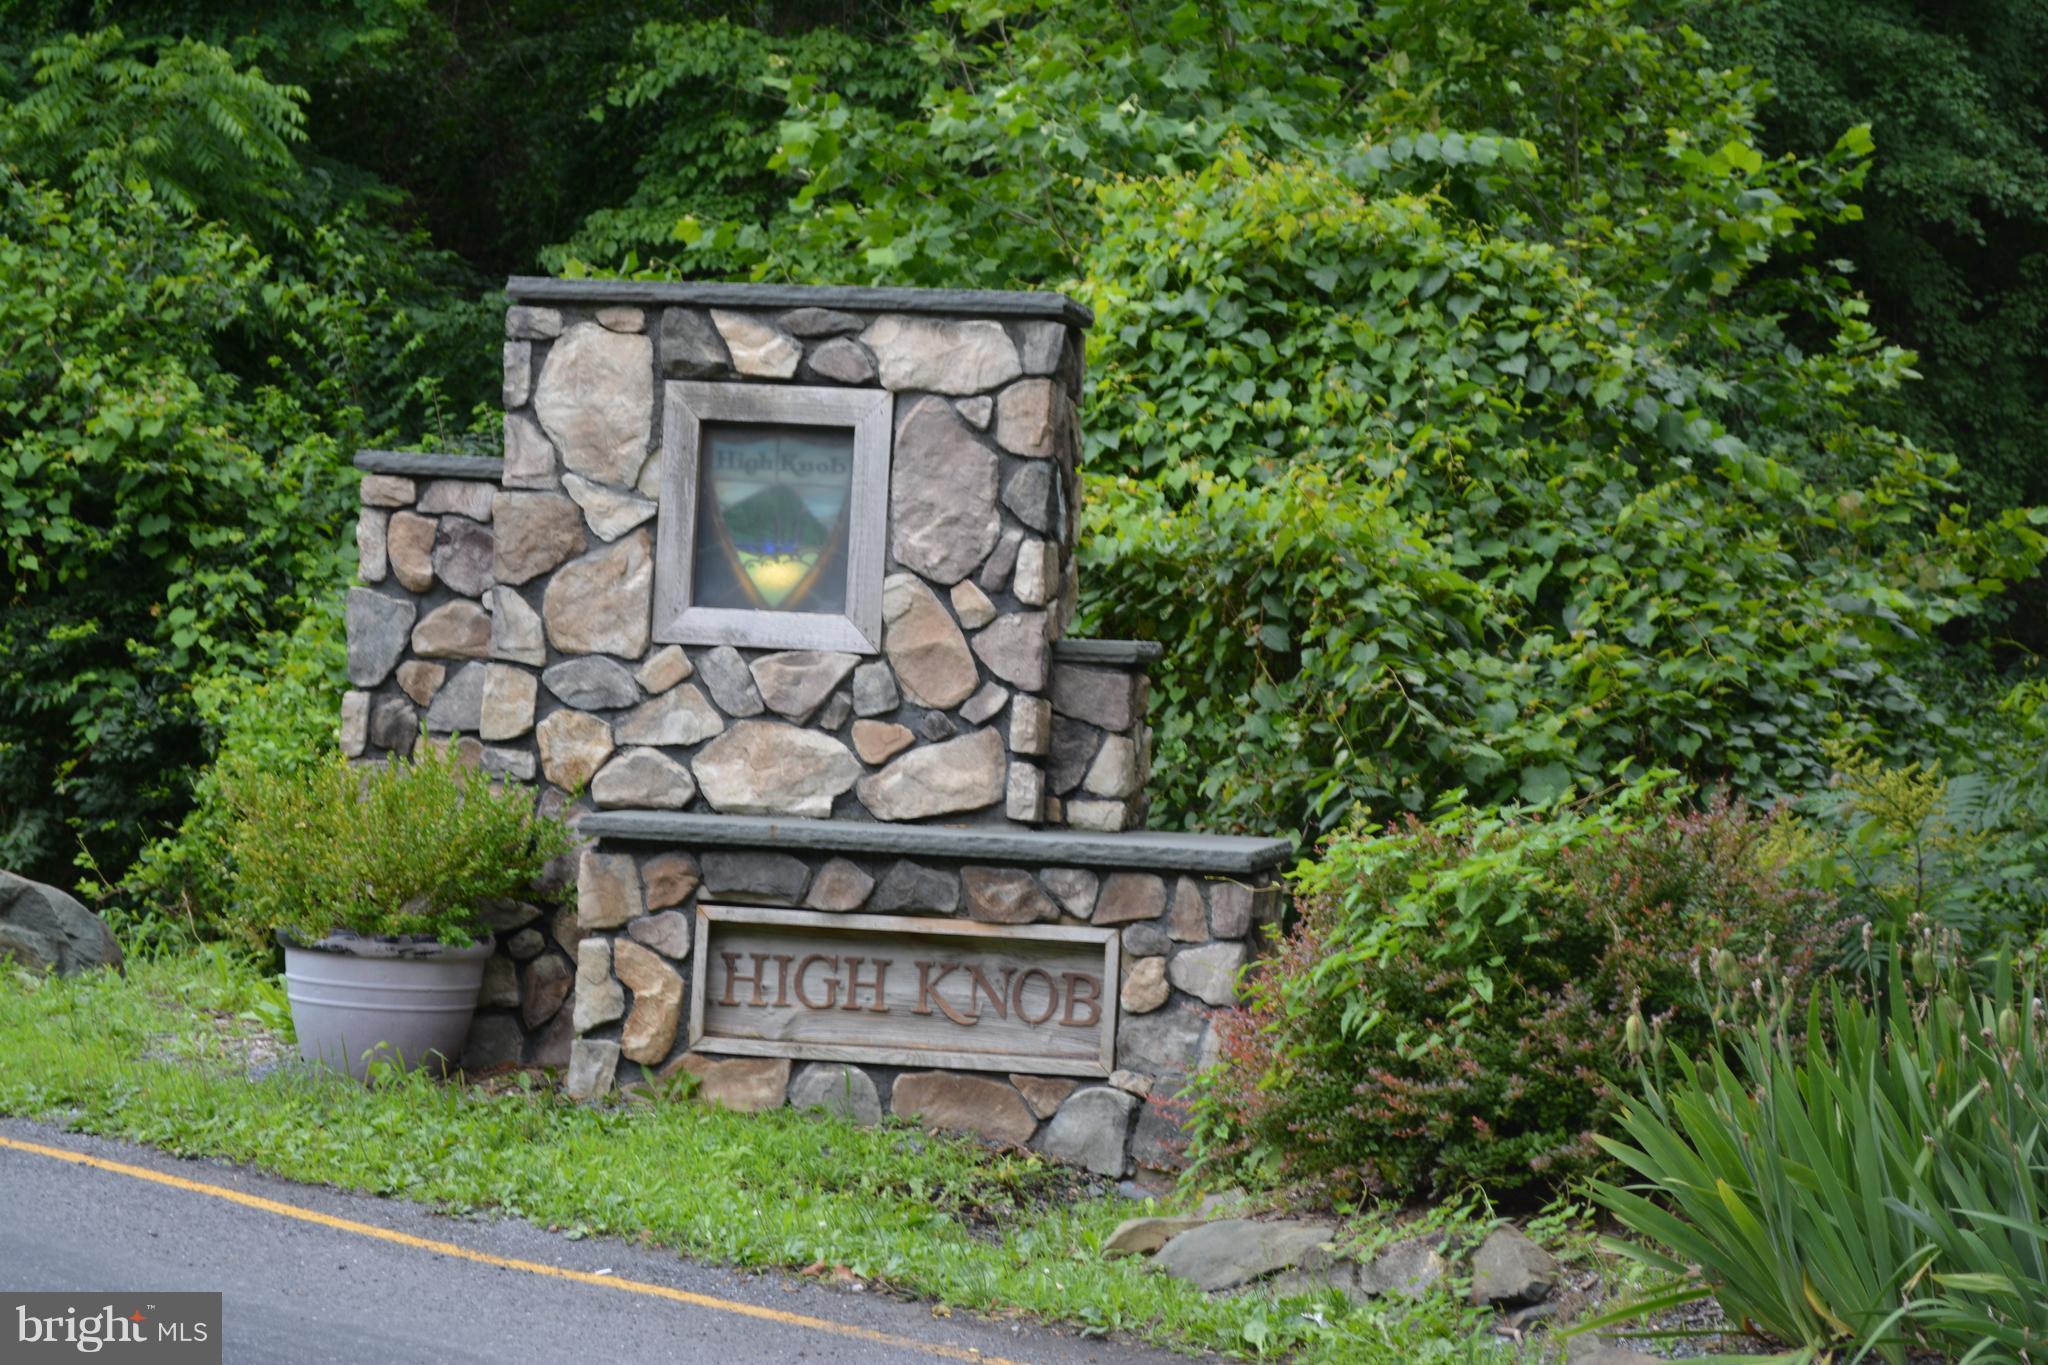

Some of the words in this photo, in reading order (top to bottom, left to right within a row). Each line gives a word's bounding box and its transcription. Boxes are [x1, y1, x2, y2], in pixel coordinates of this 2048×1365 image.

[717, 449, 773, 475] High
[780, 452, 847, 477] Knob
[718, 952, 894, 1013] HIGH
[911, 960, 1101, 1027] KNOB
